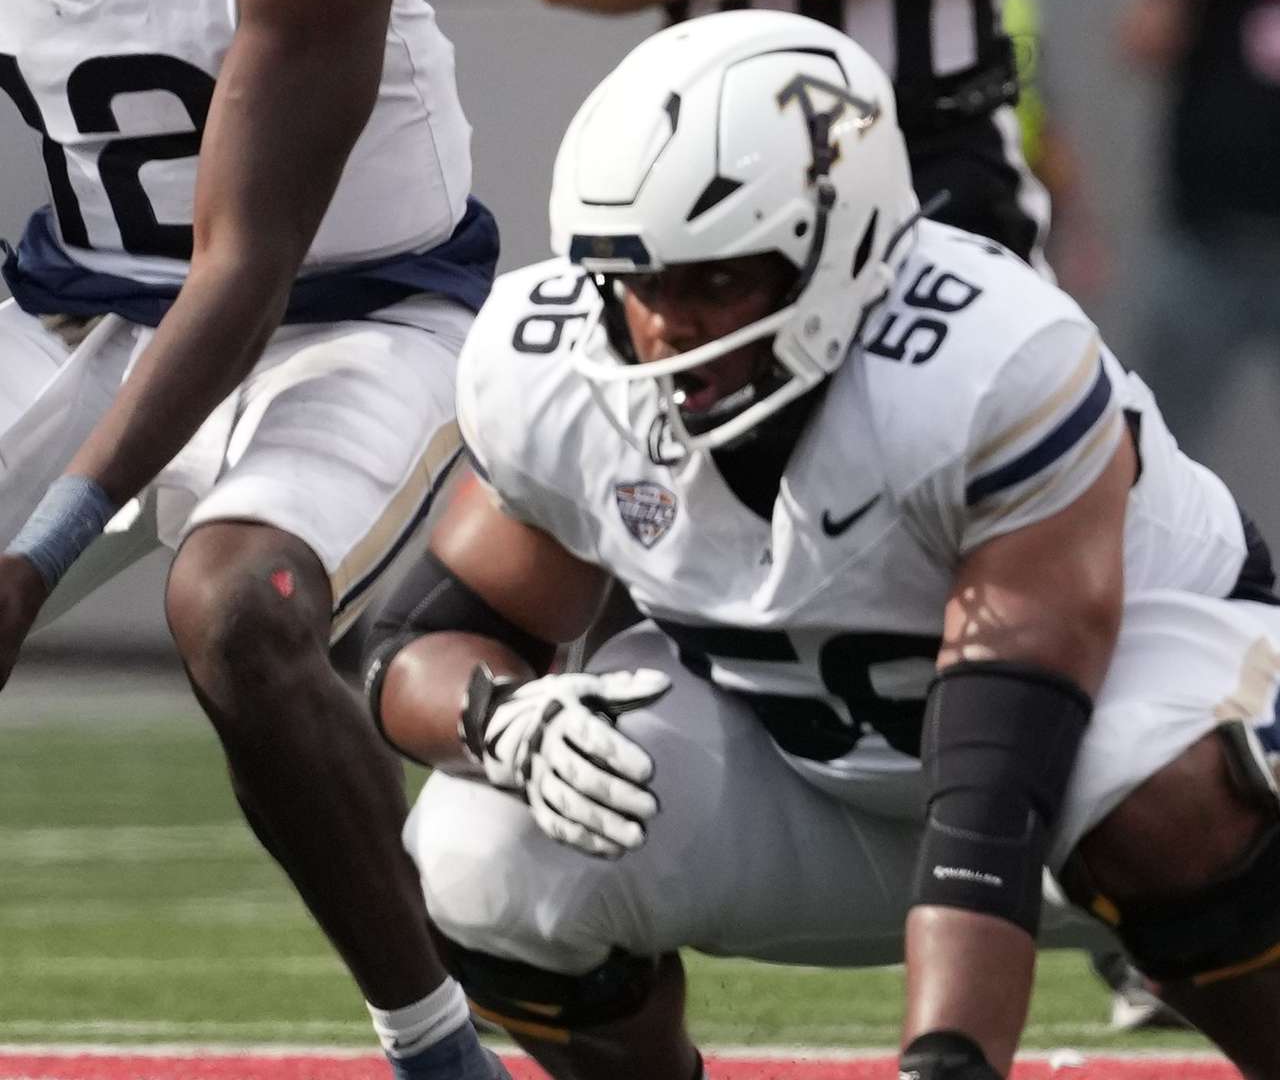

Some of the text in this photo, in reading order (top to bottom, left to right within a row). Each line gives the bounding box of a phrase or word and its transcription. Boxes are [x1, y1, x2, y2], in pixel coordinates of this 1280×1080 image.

[0, 51, 217, 261] 12
[773, 73, 881, 190] A
[866, 264, 983, 365] 56
